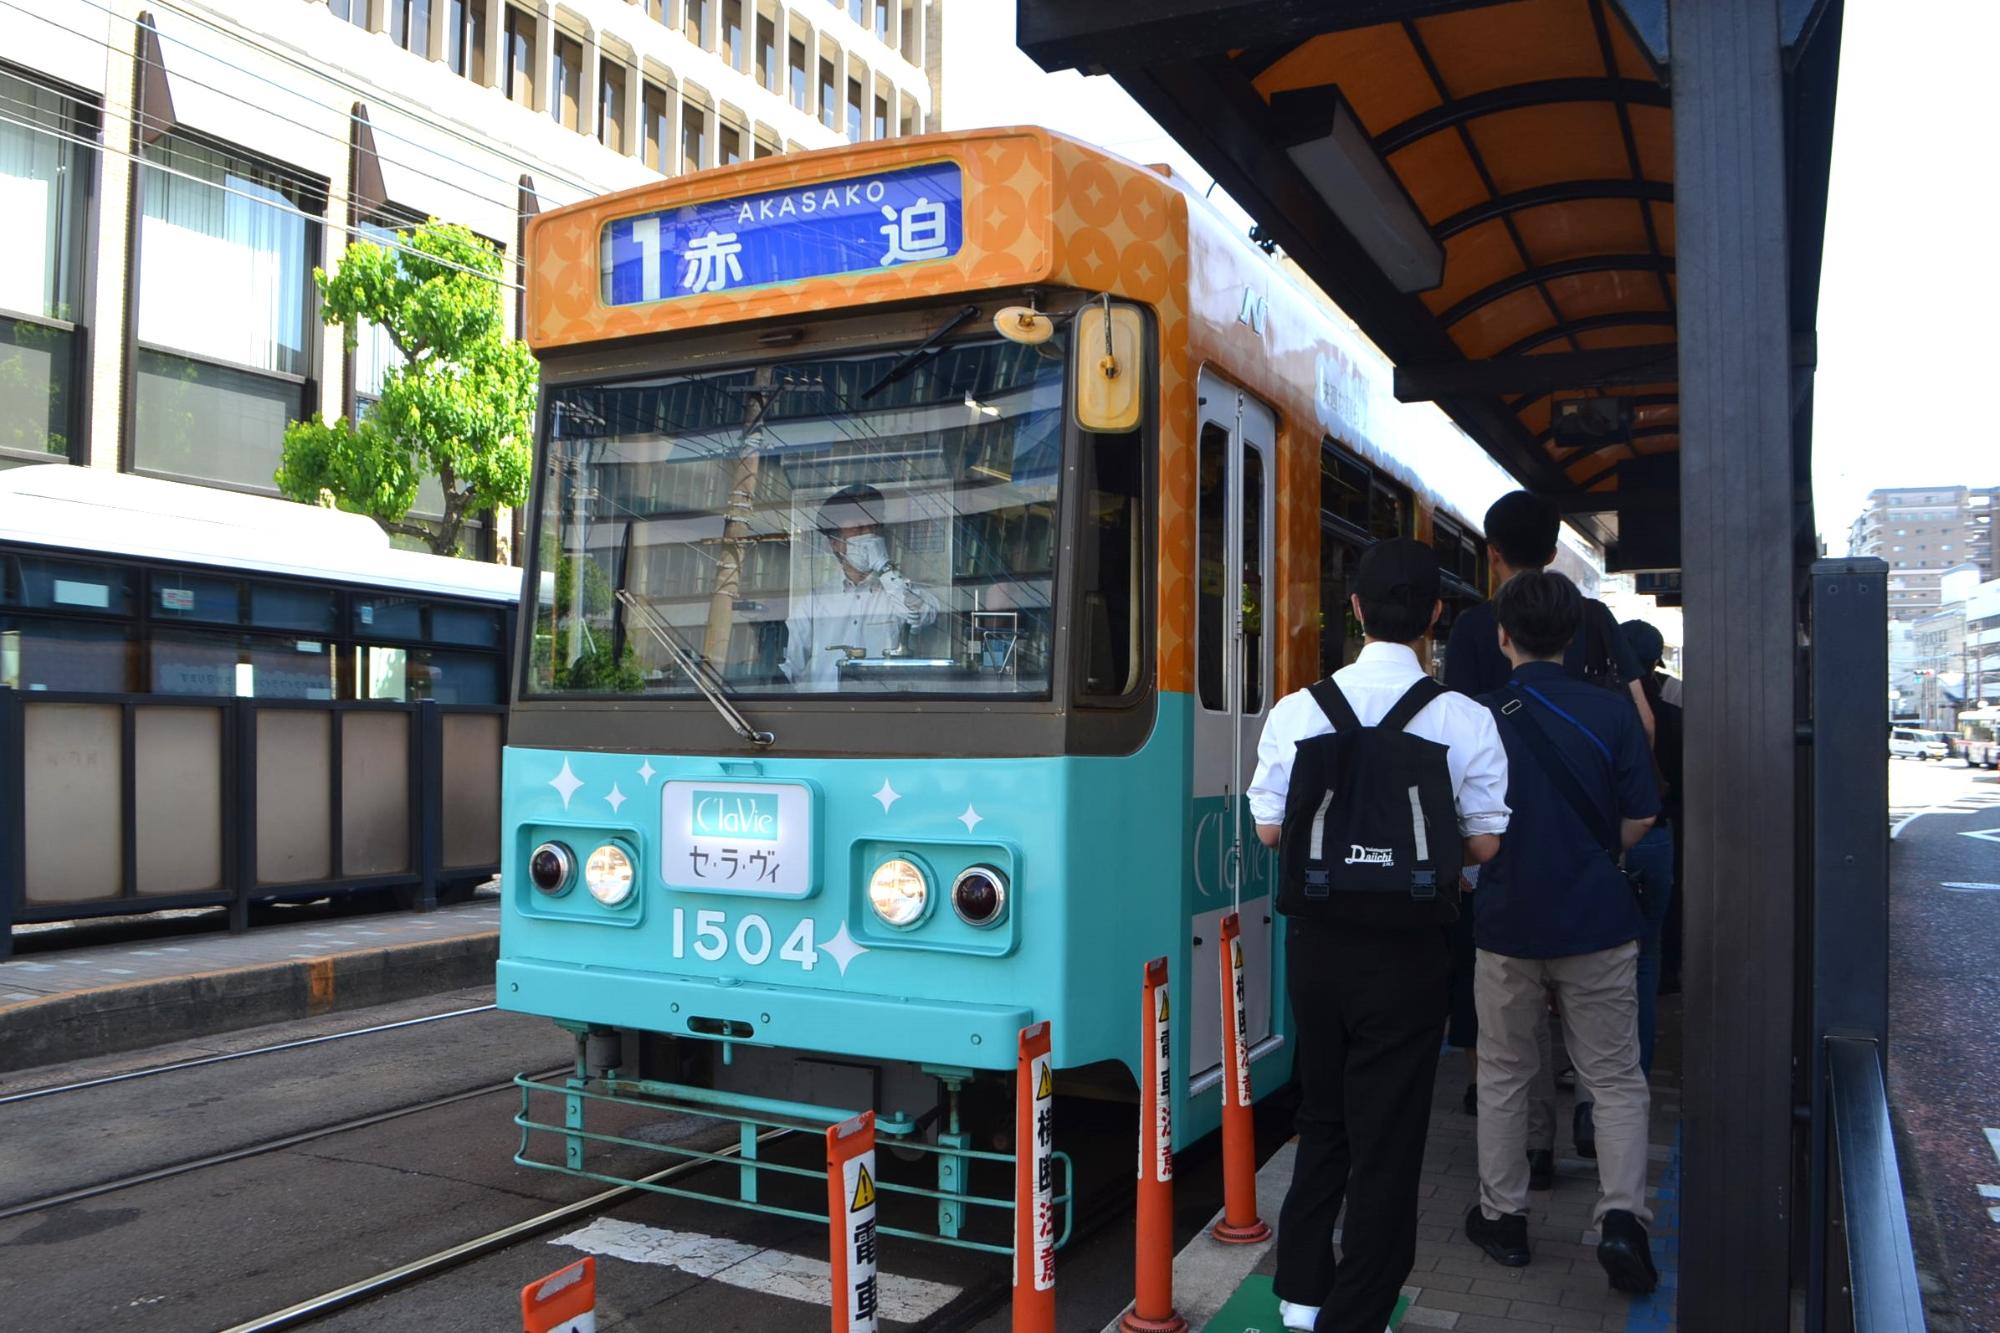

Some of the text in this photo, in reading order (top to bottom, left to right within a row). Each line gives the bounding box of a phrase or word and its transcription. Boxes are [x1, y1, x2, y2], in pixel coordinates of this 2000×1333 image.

[737, 180, 886, 225] AKASAKO
[632, 218, 661, 303] 1
[1344, 844, 1393, 865] Daiichi
[672, 907, 819, 971] 1504
